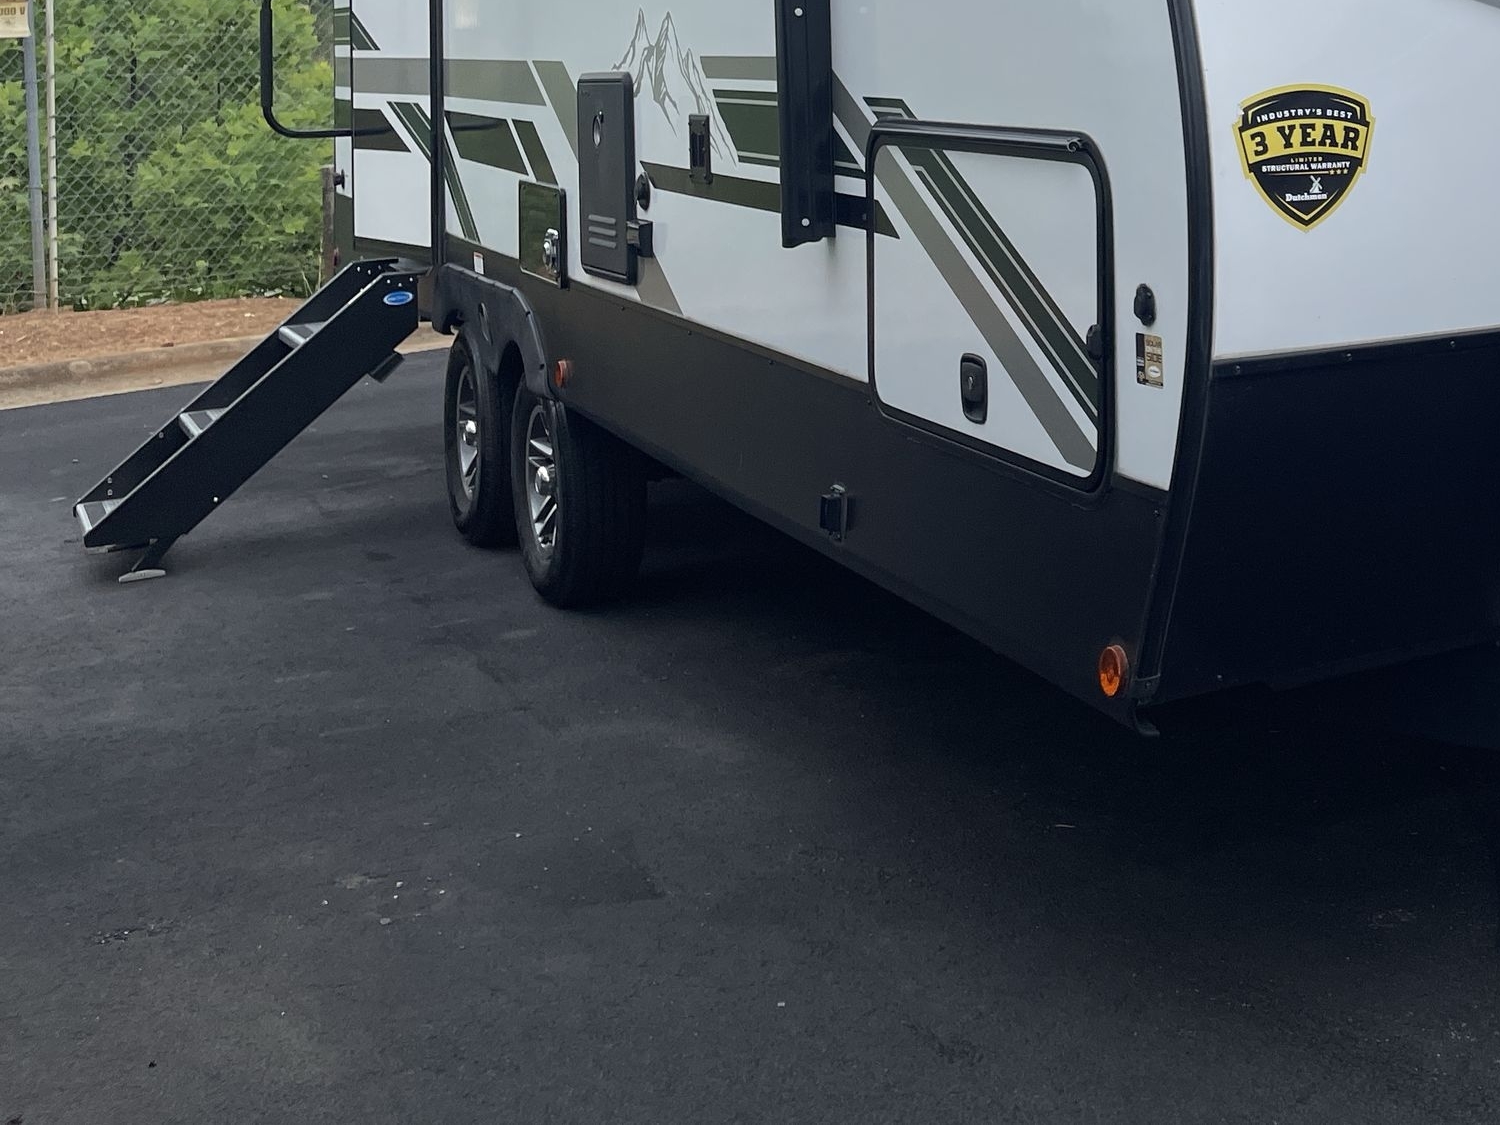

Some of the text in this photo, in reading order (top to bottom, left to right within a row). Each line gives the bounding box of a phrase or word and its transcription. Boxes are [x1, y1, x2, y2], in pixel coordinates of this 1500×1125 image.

[1256, 108, 1353, 124] INDUSTRY'S BEST
[1250, 122, 1361, 157] 3 YEAR
[1290, 155, 1323, 163] LIMITED
[1261, 160, 1351, 173] STRUCTURAL WARRANTY
